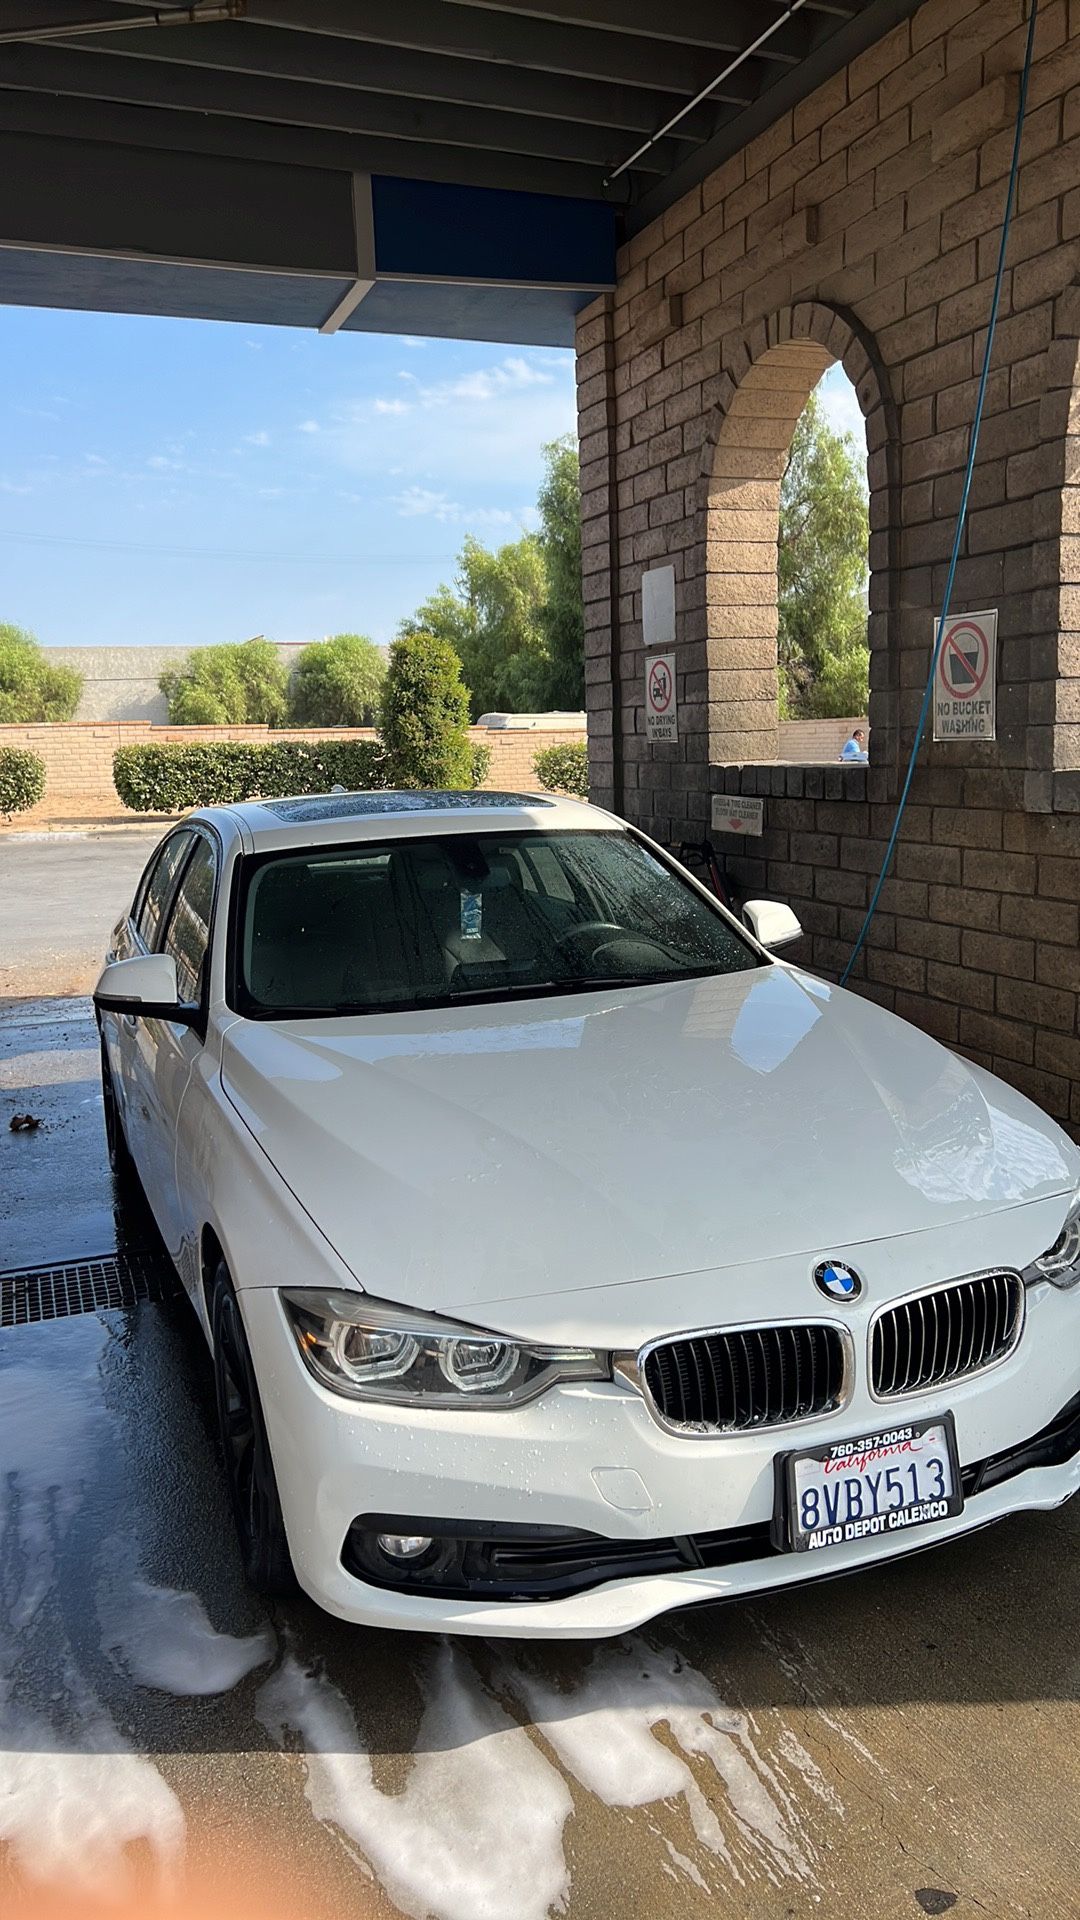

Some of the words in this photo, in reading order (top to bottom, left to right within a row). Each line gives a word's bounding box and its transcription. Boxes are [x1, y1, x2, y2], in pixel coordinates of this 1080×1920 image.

[937, 702, 950, 716] NO
[952, 700, 991, 715] BUCKET
[648, 715, 655, 726] NO
[656, 714, 675, 725] DRYING
[942, 719, 985, 734] WASHING
[659, 727, 671, 738] BAYS
[816, 1261, 849, 1277] BMW
[830, 1427, 913, 1458] 760-357-0043
[823, 1441, 923, 1474] California
[801, 1457, 946, 1530] 8VBY513
[808, 1527, 842, 1549] AUTO
[845, 1516, 887, 1539] DEPOT
[889, 1500, 948, 1529] CALEXICO
